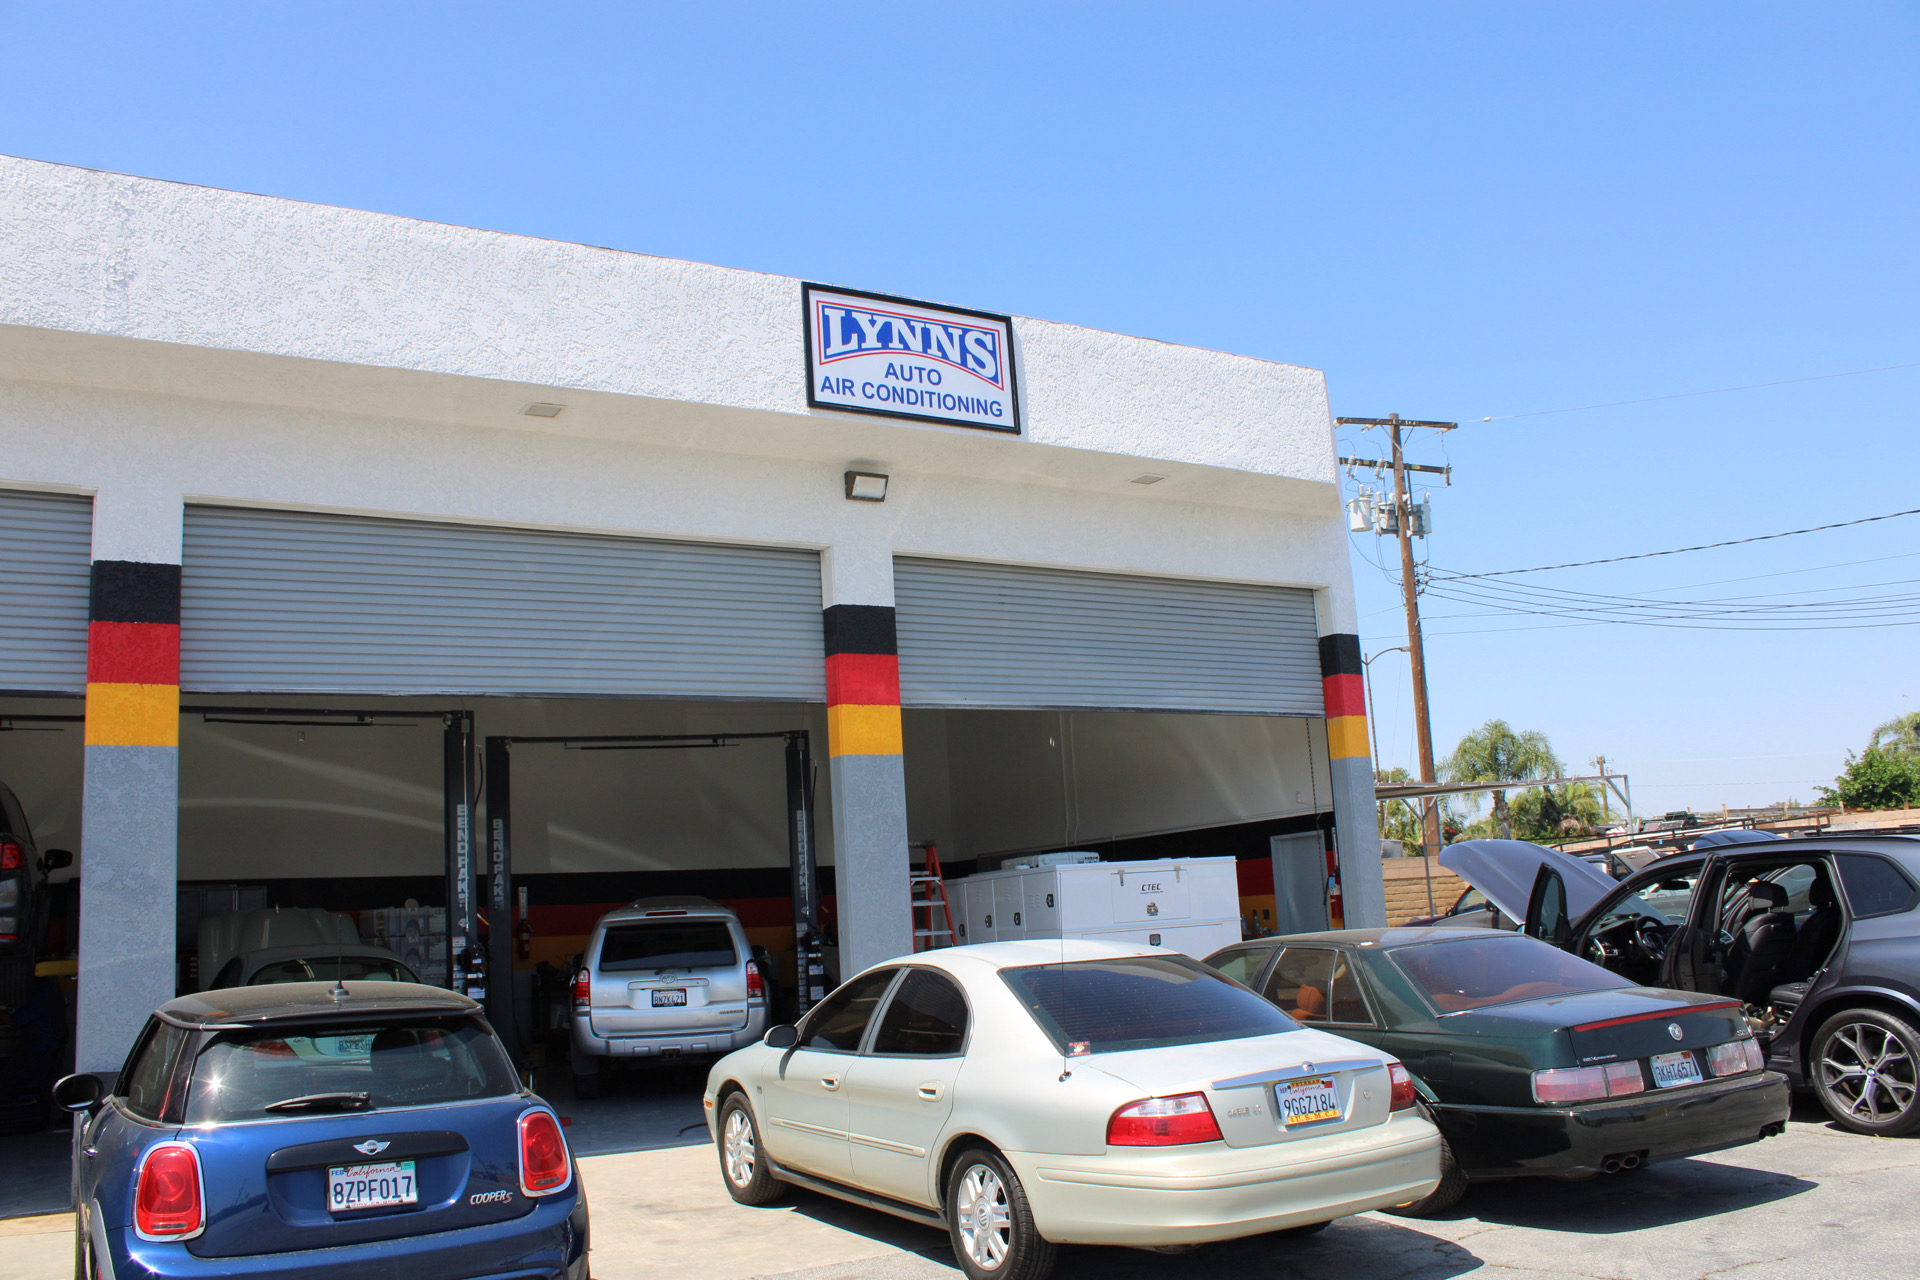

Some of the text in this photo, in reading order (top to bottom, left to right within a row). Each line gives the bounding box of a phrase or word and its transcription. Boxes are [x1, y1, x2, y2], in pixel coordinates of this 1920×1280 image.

[825, 307, 996, 378] LYNNS
[884, 362, 942, 385] AUTO
[820, 376, 1003, 417] AIR CONDITIONING
[1141, 883, 1161, 891] CTEC
[1289, 1085, 1323, 1095] California
[1292, 1079, 1320, 1088] VETERAN
[1283, 1093, 1335, 1117] 9GGZ184
[346, 1165, 401, 1179] California
[333, 1176, 412, 1204] 8ZPF017
[470, 1190, 506, 1205] COOPER
[351, 1199, 398, 1207] dmv.ca.gov
